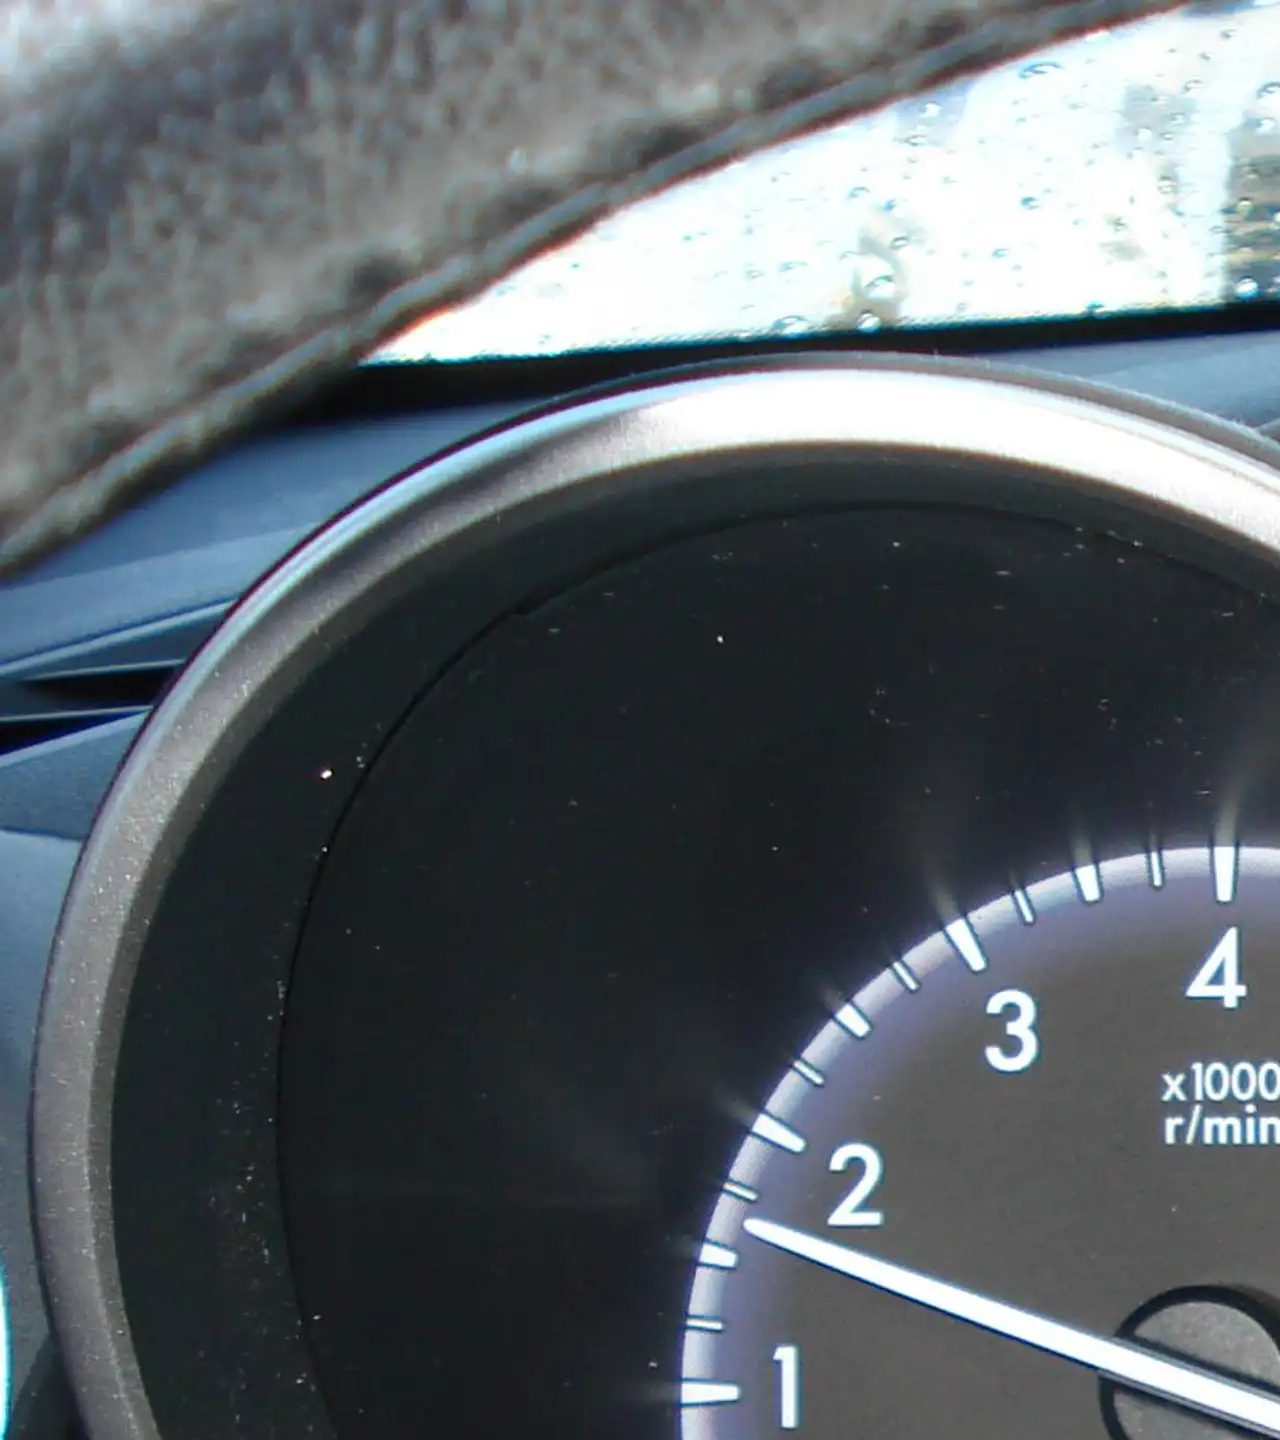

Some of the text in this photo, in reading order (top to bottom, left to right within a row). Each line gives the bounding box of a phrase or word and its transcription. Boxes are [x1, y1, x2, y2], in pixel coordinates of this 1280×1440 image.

[1185, 926, 1247, 1008] 4
[985, 989, 1037, 1072] 3
[827, 1143, 882, 1226] 2
[773, 1345, 797, 1428] 1
